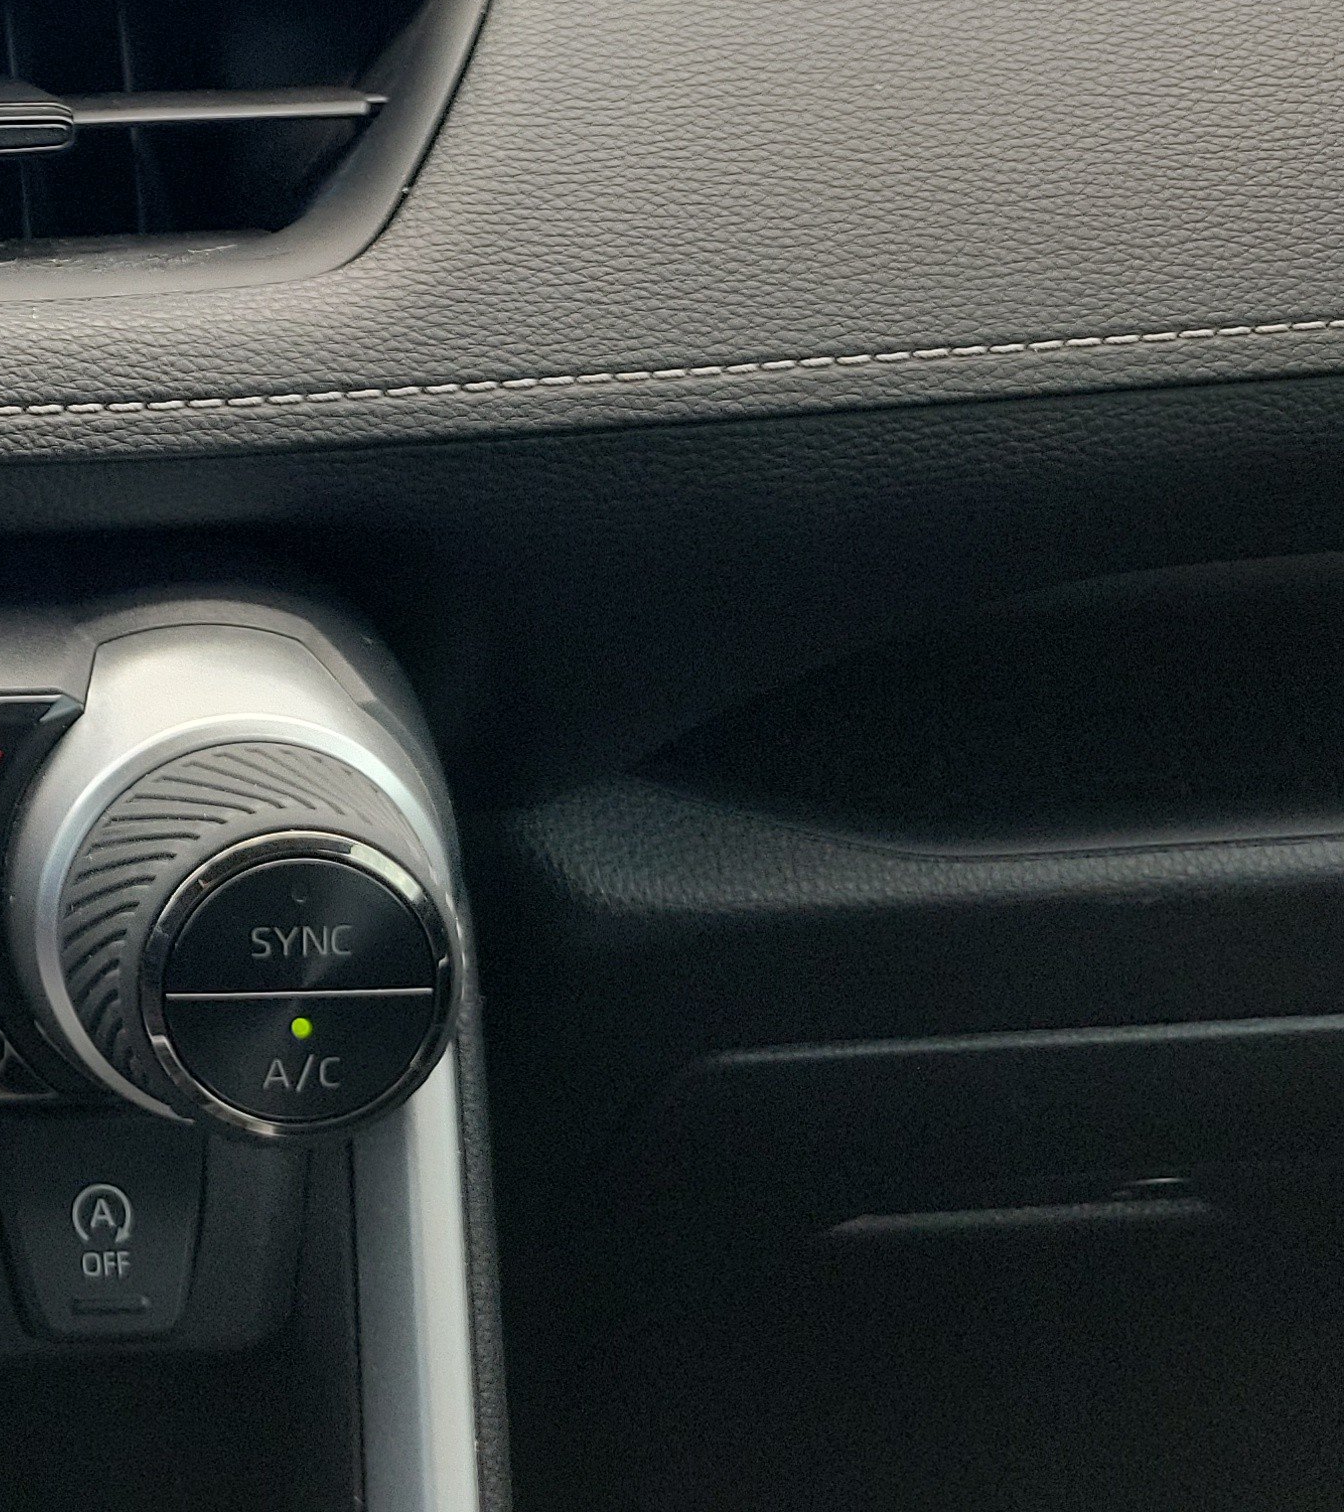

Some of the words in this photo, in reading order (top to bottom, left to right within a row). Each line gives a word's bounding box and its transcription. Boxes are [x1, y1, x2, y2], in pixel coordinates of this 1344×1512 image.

[251, 924, 354, 960] SYNC
[262, 1054, 340, 1093] A/C
[82, 1250, 130, 1278] OFF
